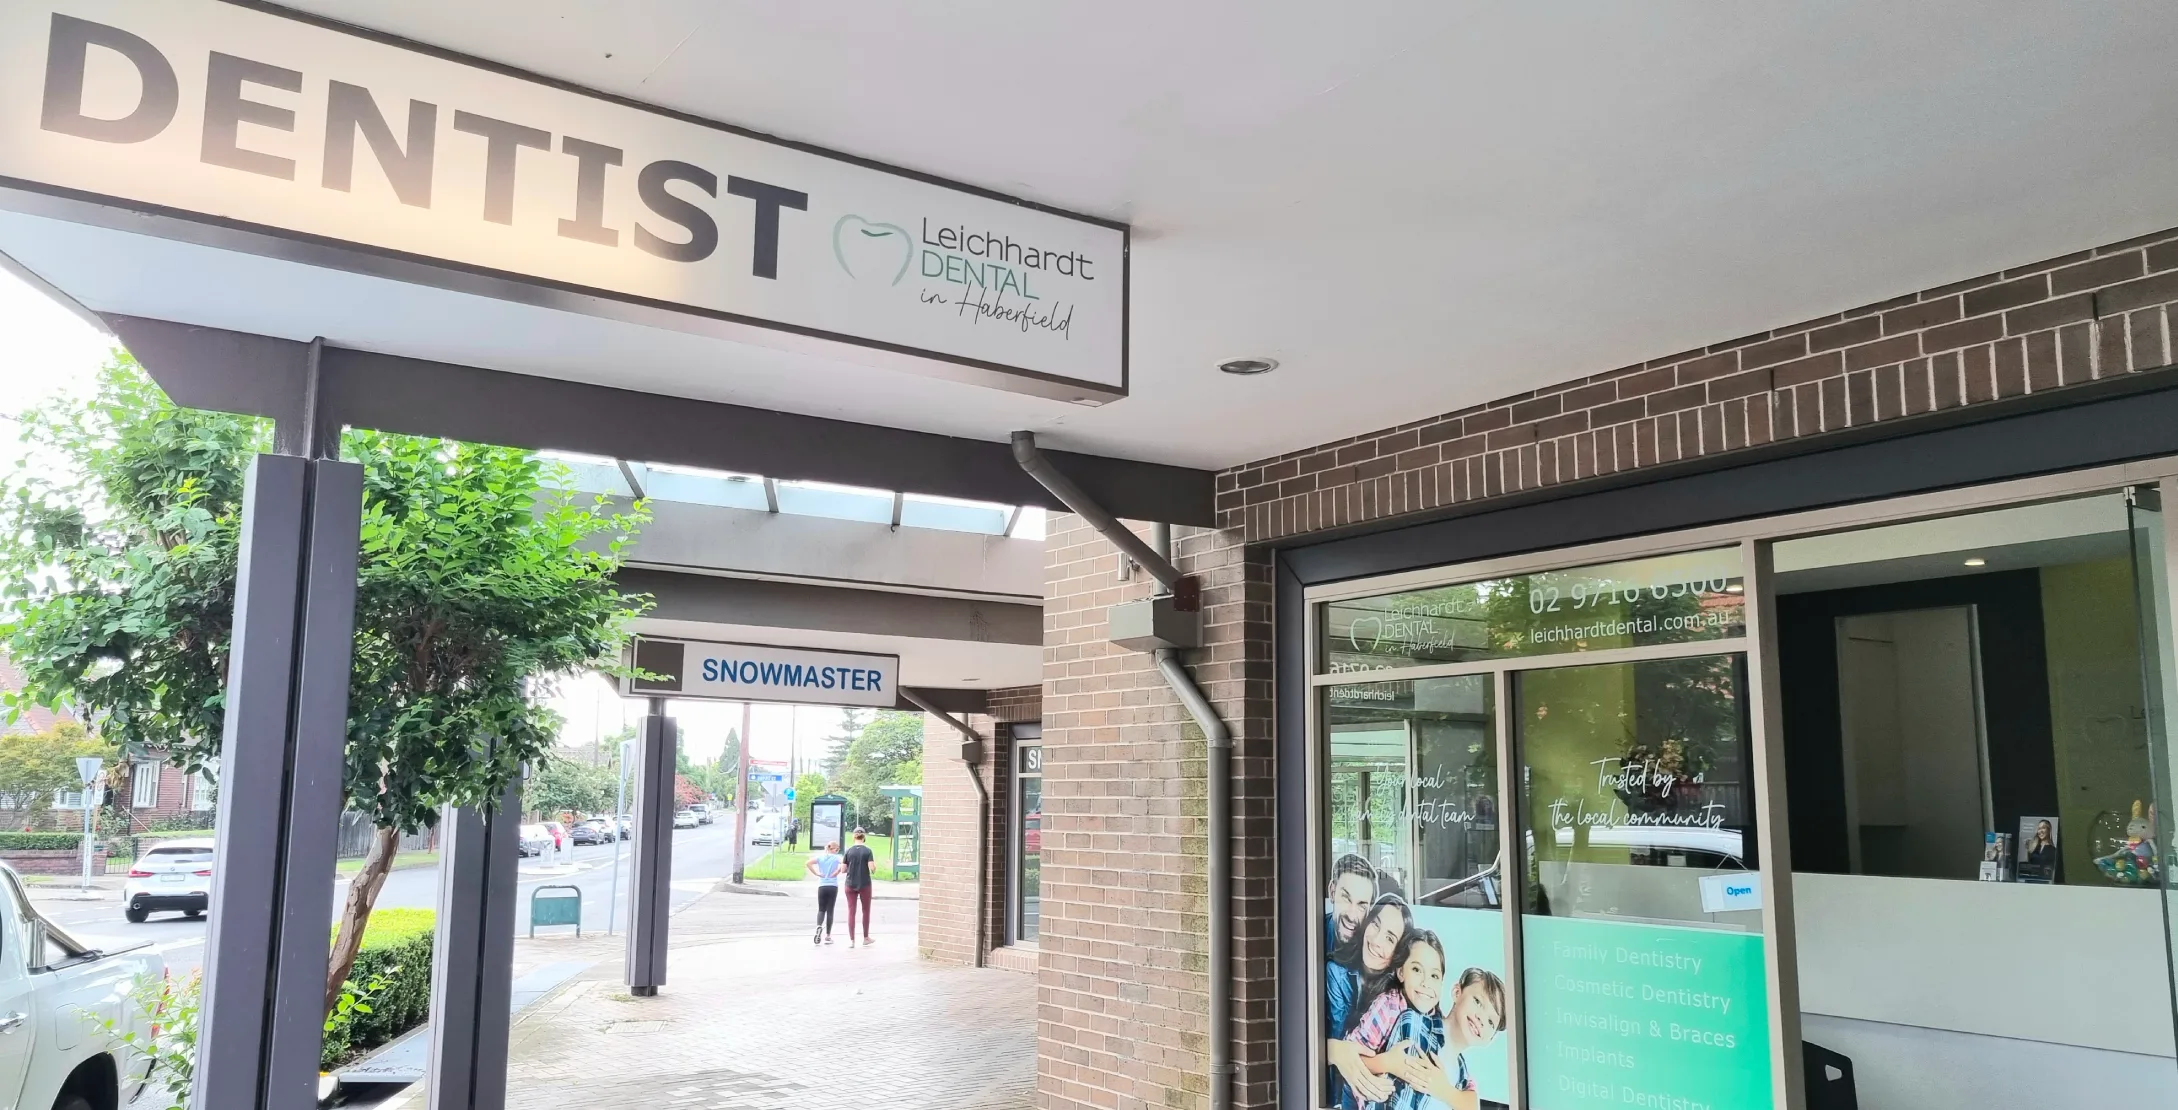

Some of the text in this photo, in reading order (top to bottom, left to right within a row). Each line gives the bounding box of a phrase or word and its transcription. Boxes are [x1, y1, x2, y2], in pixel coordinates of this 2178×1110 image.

[40, 11, 809, 280] DENTIST
[921, 216, 1095, 281] Leichhardt
[921, 249, 1041, 301] DENTAL
[920, 280, 1075, 340] in Haberfield
[1384, 598, 1466, 622] Leichhardt
[1529, 586, 1561, 615] 02
[1384, 619, 1439, 639] DENTAL
[1400, 620, 1455, 656] Haberfield
[1530, 612, 1730, 644] leichhardtdental.com.au
[702, 658, 882, 692] SNOWMASTER
[1409, 763, 1445, 789] local
[1589, 757, 1676, 798] Trusted by
[1438, 800, 1476, 829] team
[1547, 798, 1726, 832] the local community
[1726, 885, 1752, 897] Open
[1553, 941, 1702, 976] Family Dentistry
[1554, 974, 1731, 1015] Cosmetic Dentistry
[1556, 1007, 1736, 1049] Invisalign & Braces
[1557, 1040, 1635, 1069] Implants
[1559, 1074, 1614, 1100] Digital
